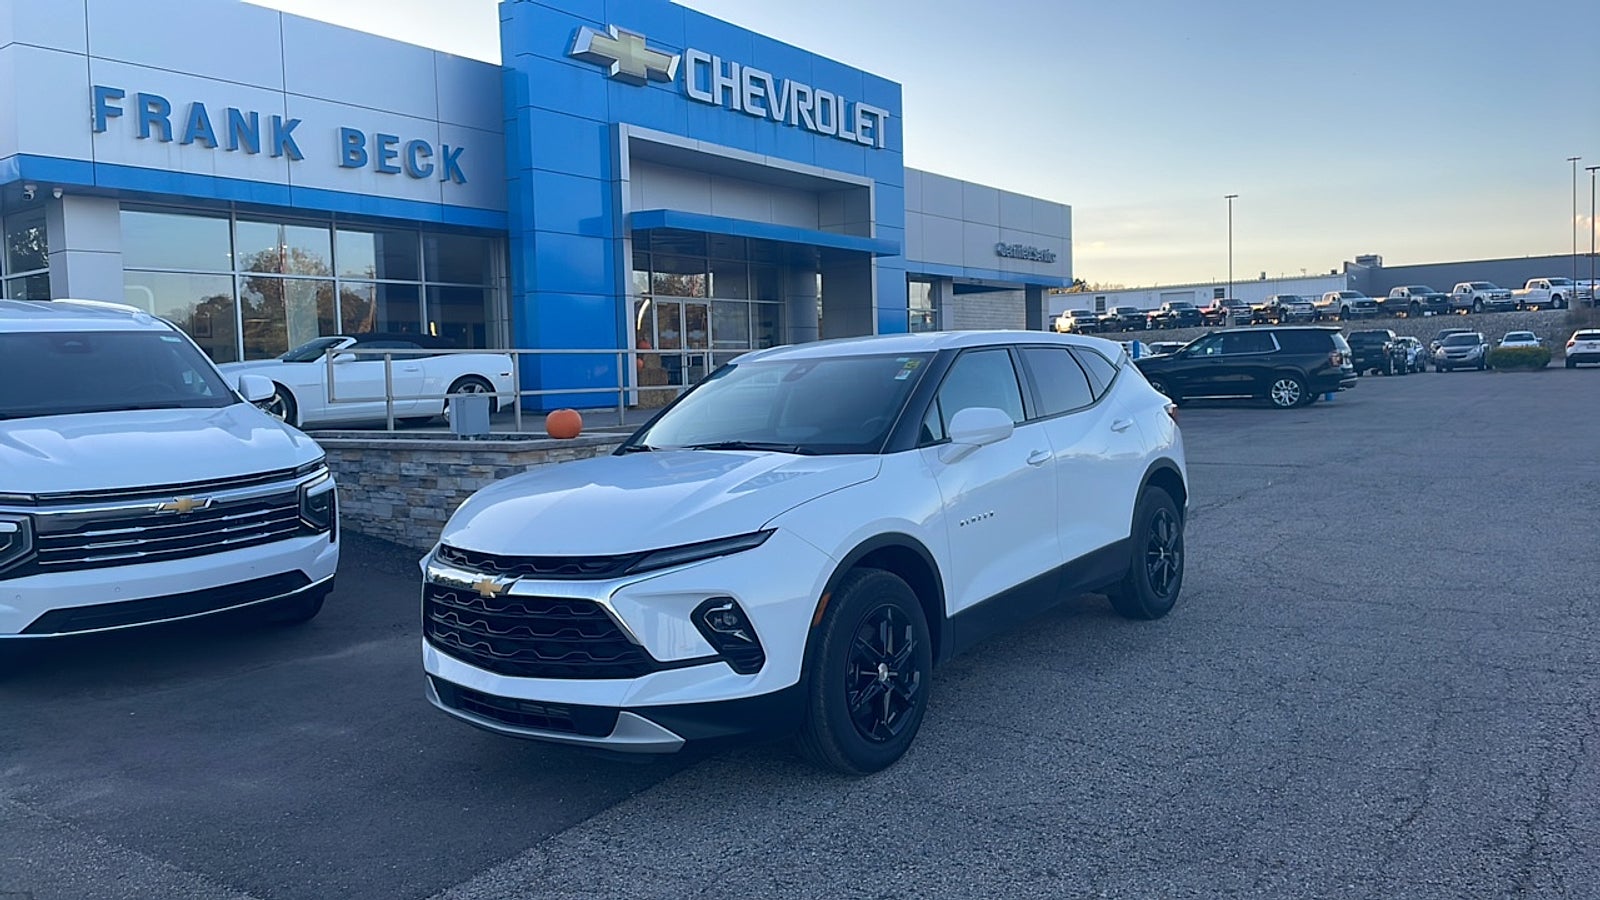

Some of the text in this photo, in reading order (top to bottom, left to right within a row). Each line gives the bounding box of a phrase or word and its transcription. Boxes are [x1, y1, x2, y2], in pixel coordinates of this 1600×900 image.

[92, 84, 469, 185] FRANK BECK
[685, 47, 890, 149] CHEVROLET
